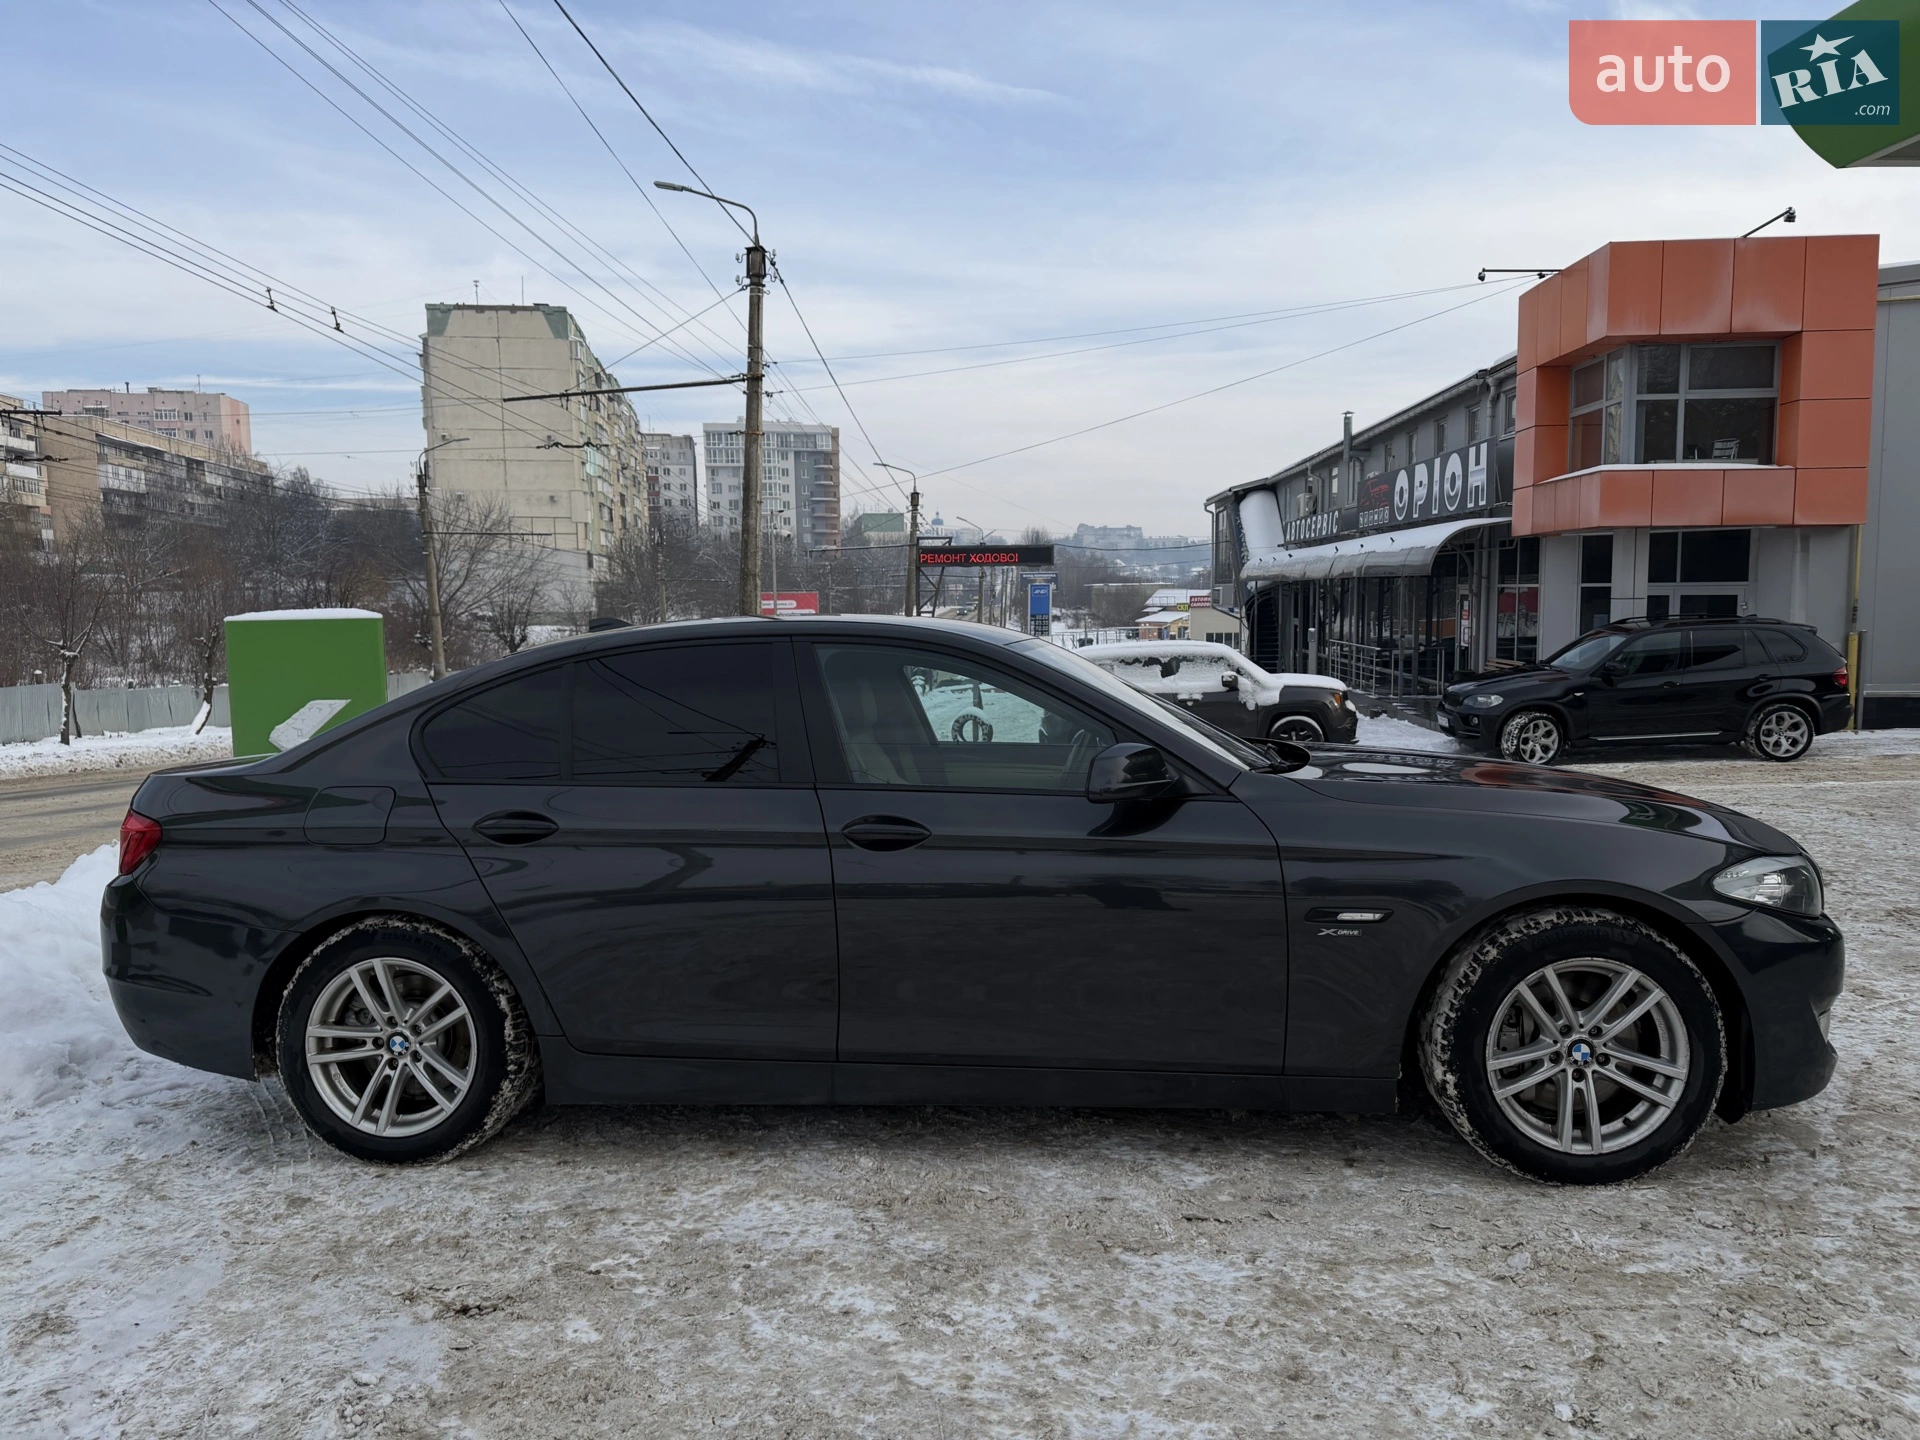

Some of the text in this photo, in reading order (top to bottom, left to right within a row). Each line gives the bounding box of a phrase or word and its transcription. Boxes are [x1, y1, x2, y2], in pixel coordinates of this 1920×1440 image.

[1394, 442, 1488, 521] ОРІОН
[1285, 510, 1339, 542] АВТОСЕРВІС
[920, 553, 967, 564] РЕМОНТ
